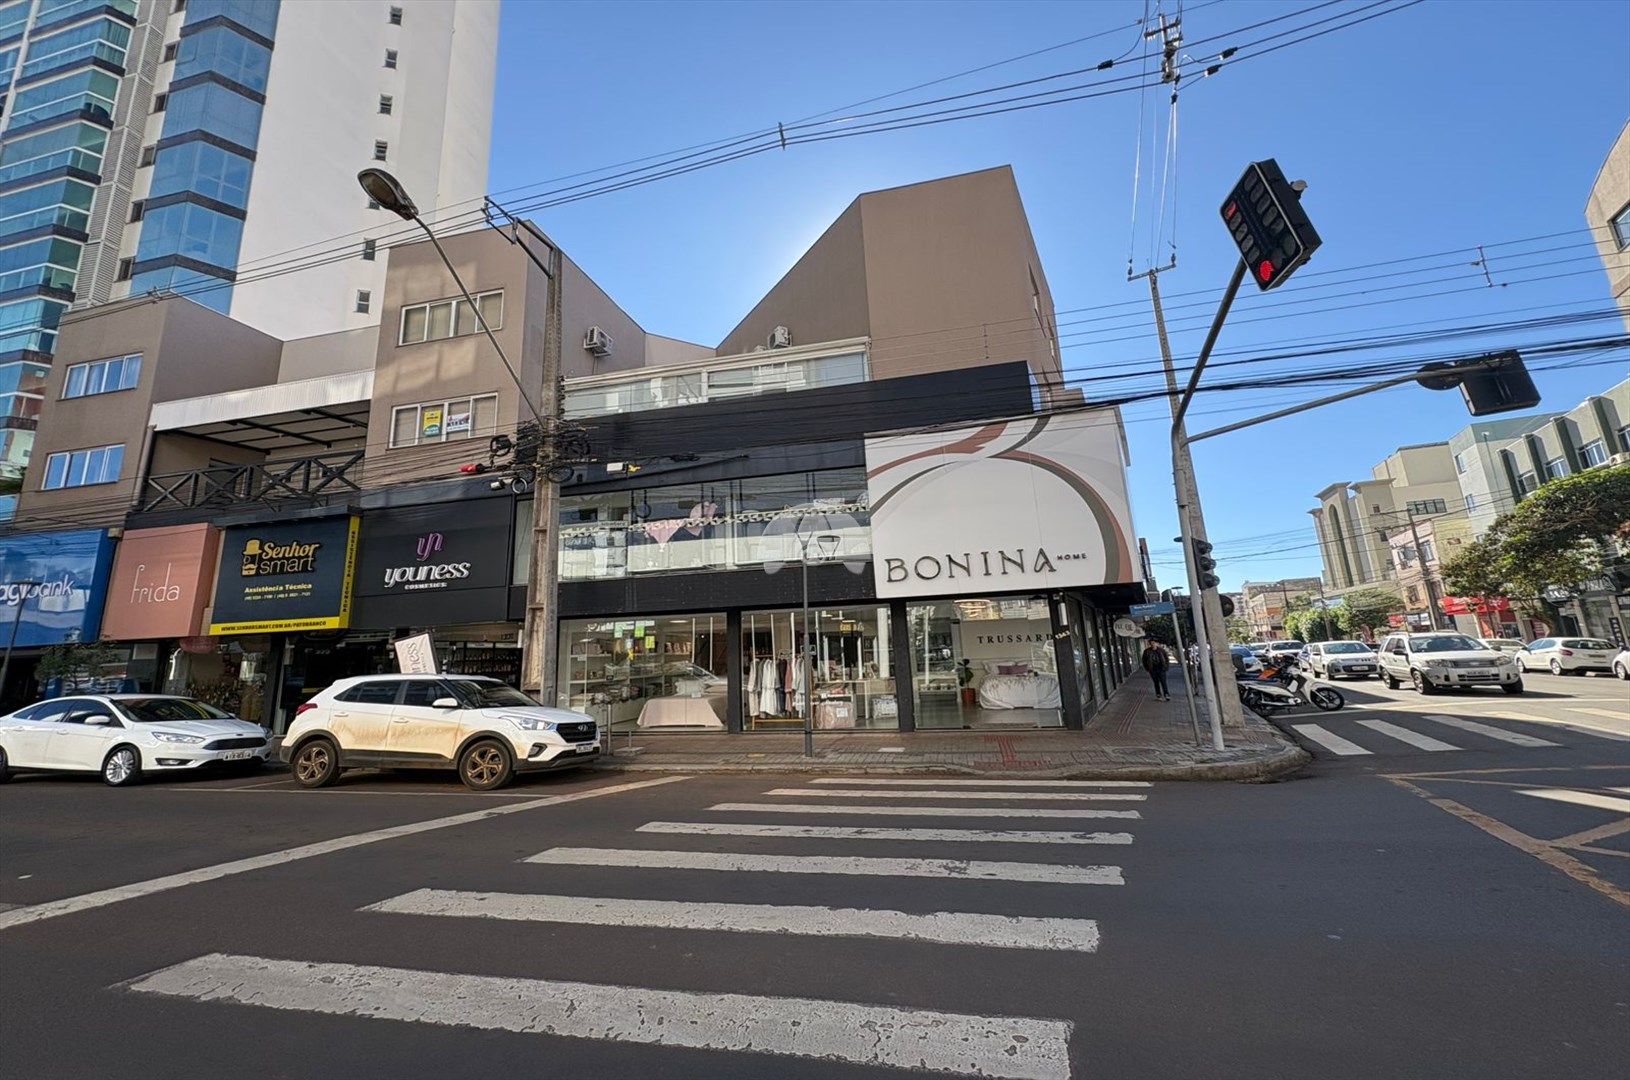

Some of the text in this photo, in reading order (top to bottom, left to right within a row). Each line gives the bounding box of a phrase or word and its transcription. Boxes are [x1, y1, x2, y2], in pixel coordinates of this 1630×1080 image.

[262, 542, 320, 559] Senhor
[259, 556, 314, 574] smart
[384, 562, 471, 588] youness
[884, 548, 1087, 583] BONINA HOME
[130, 562, 180, 603] frida
[244, 583, 312, 593] Assistência Técnica
